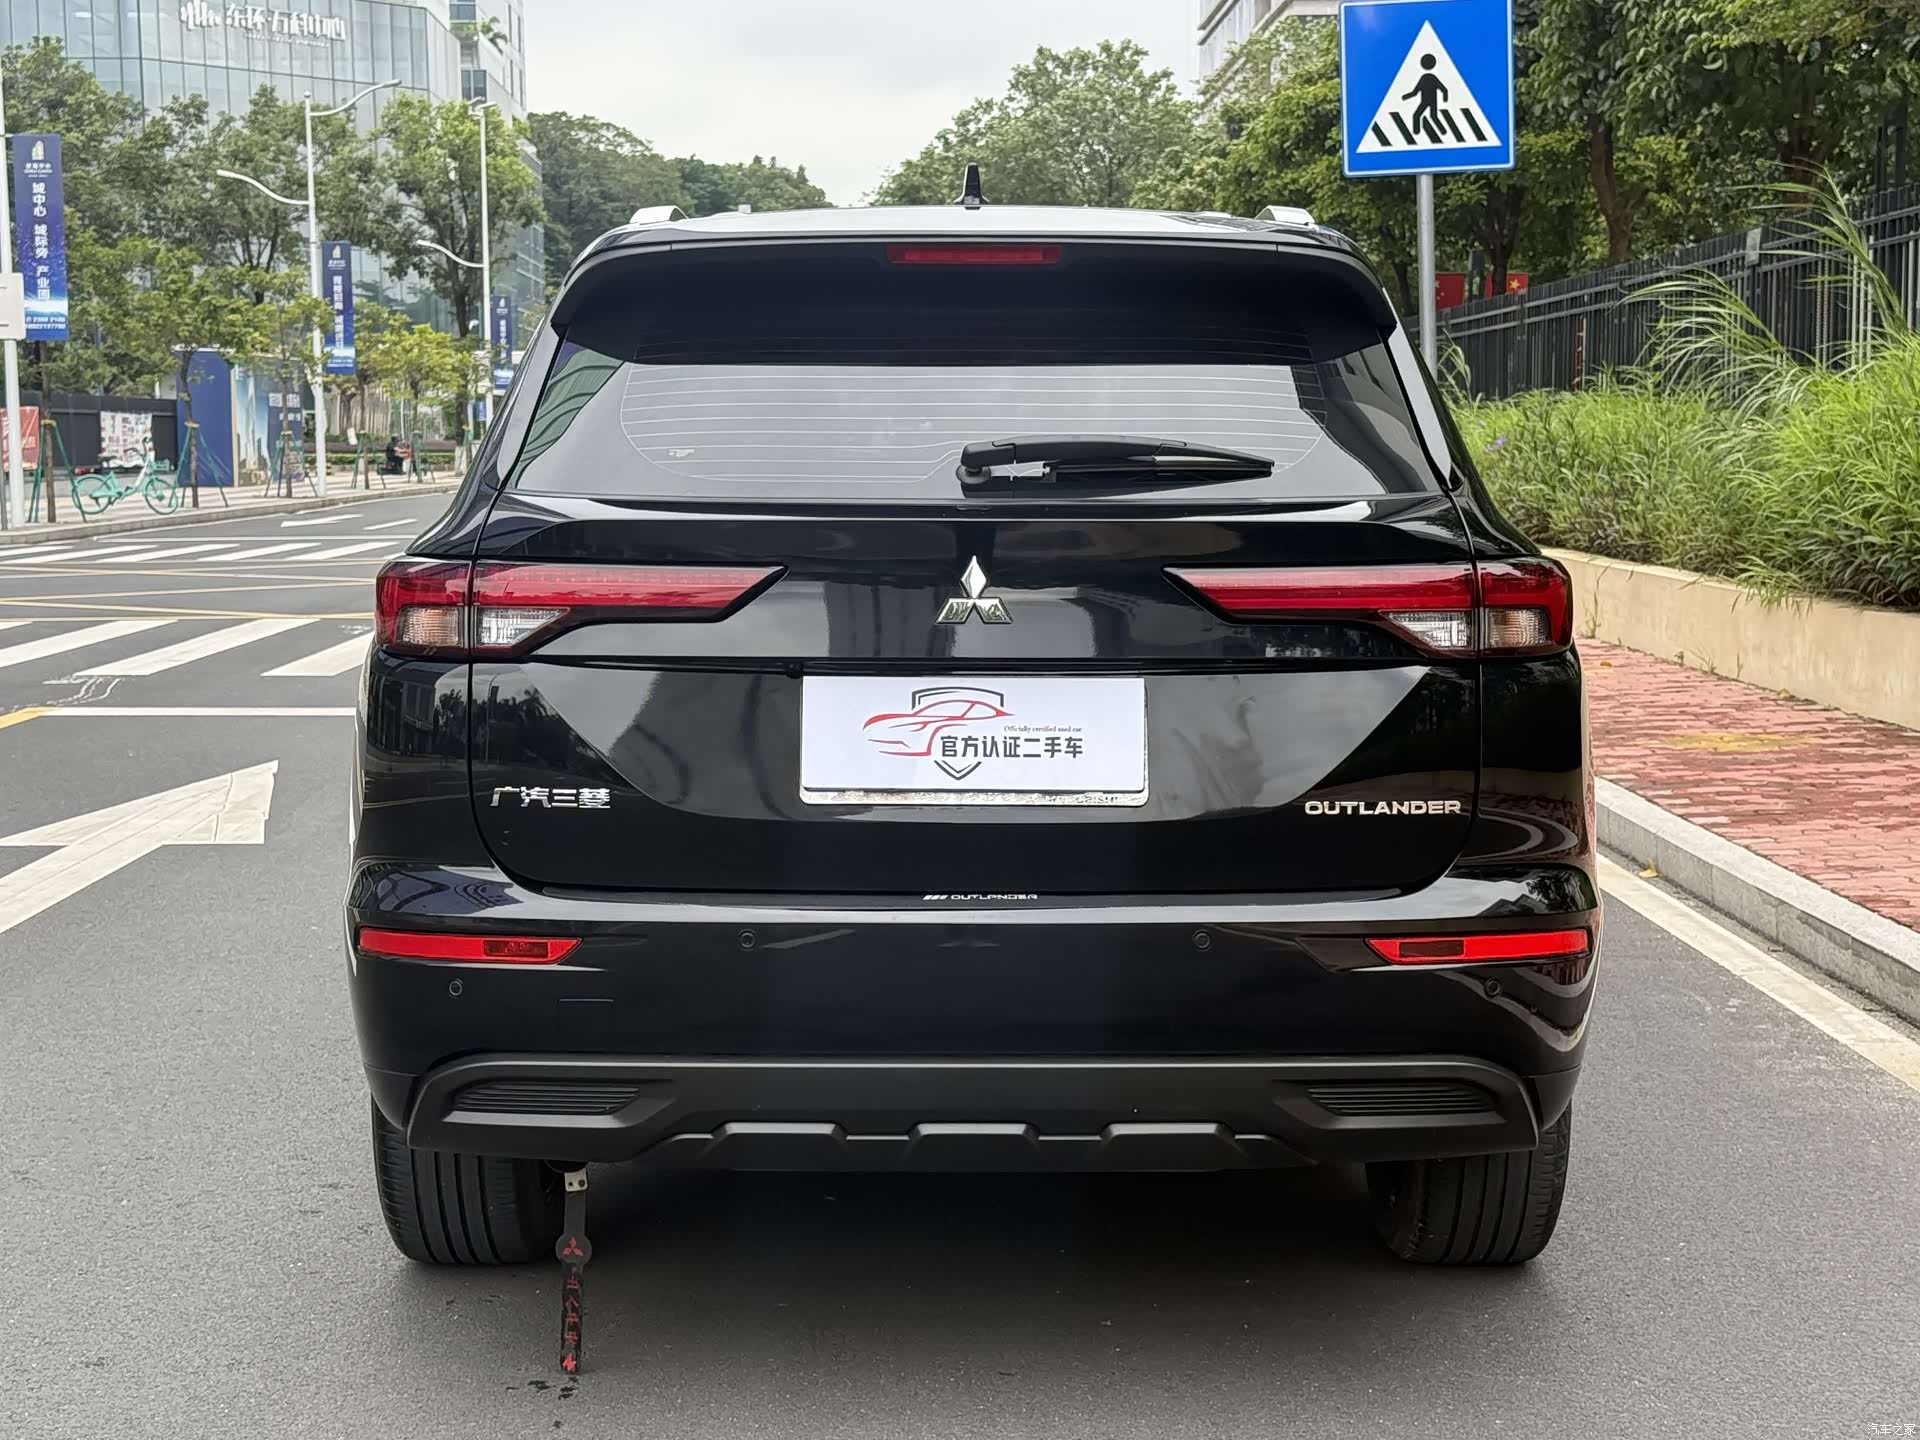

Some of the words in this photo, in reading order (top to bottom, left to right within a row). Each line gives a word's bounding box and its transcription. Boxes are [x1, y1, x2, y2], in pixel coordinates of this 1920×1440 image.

[1003, 725, 1031, 734] Officially
[1058, 725, 1072, 733] used
[940, 735, 1084, 759] 官方认证二手车
[490, 786, 611, 809] 广汽三菱
[1304, 800, 1462, 816] OUTLANDER
[950, 893, 1039, 901] OUTLANDER
